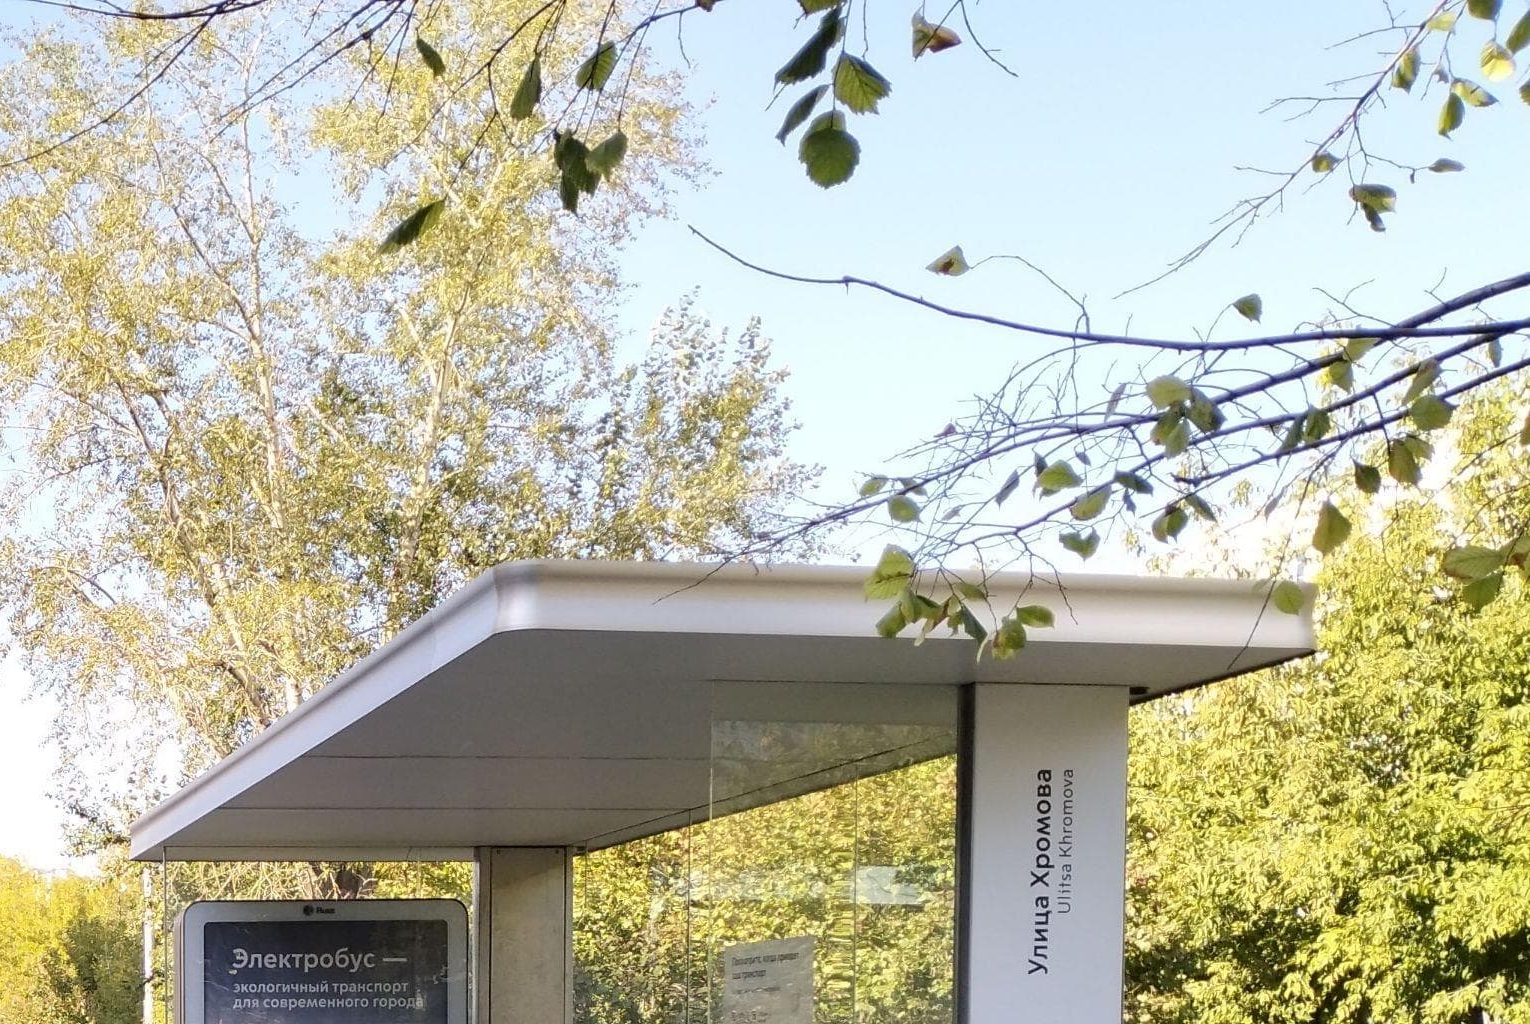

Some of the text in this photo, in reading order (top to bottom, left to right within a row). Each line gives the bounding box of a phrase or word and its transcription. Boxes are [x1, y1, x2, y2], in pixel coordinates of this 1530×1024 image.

[1057, 769, 1074, 914] Ulitsa Khromova
[1028, 769, 1055, 975] Улица Хромова
[232, 947, 376, 973] Электробус
[233, 980, 409, 996] экологичный транспорт
[233, 997, 425, 1011] для современного города
